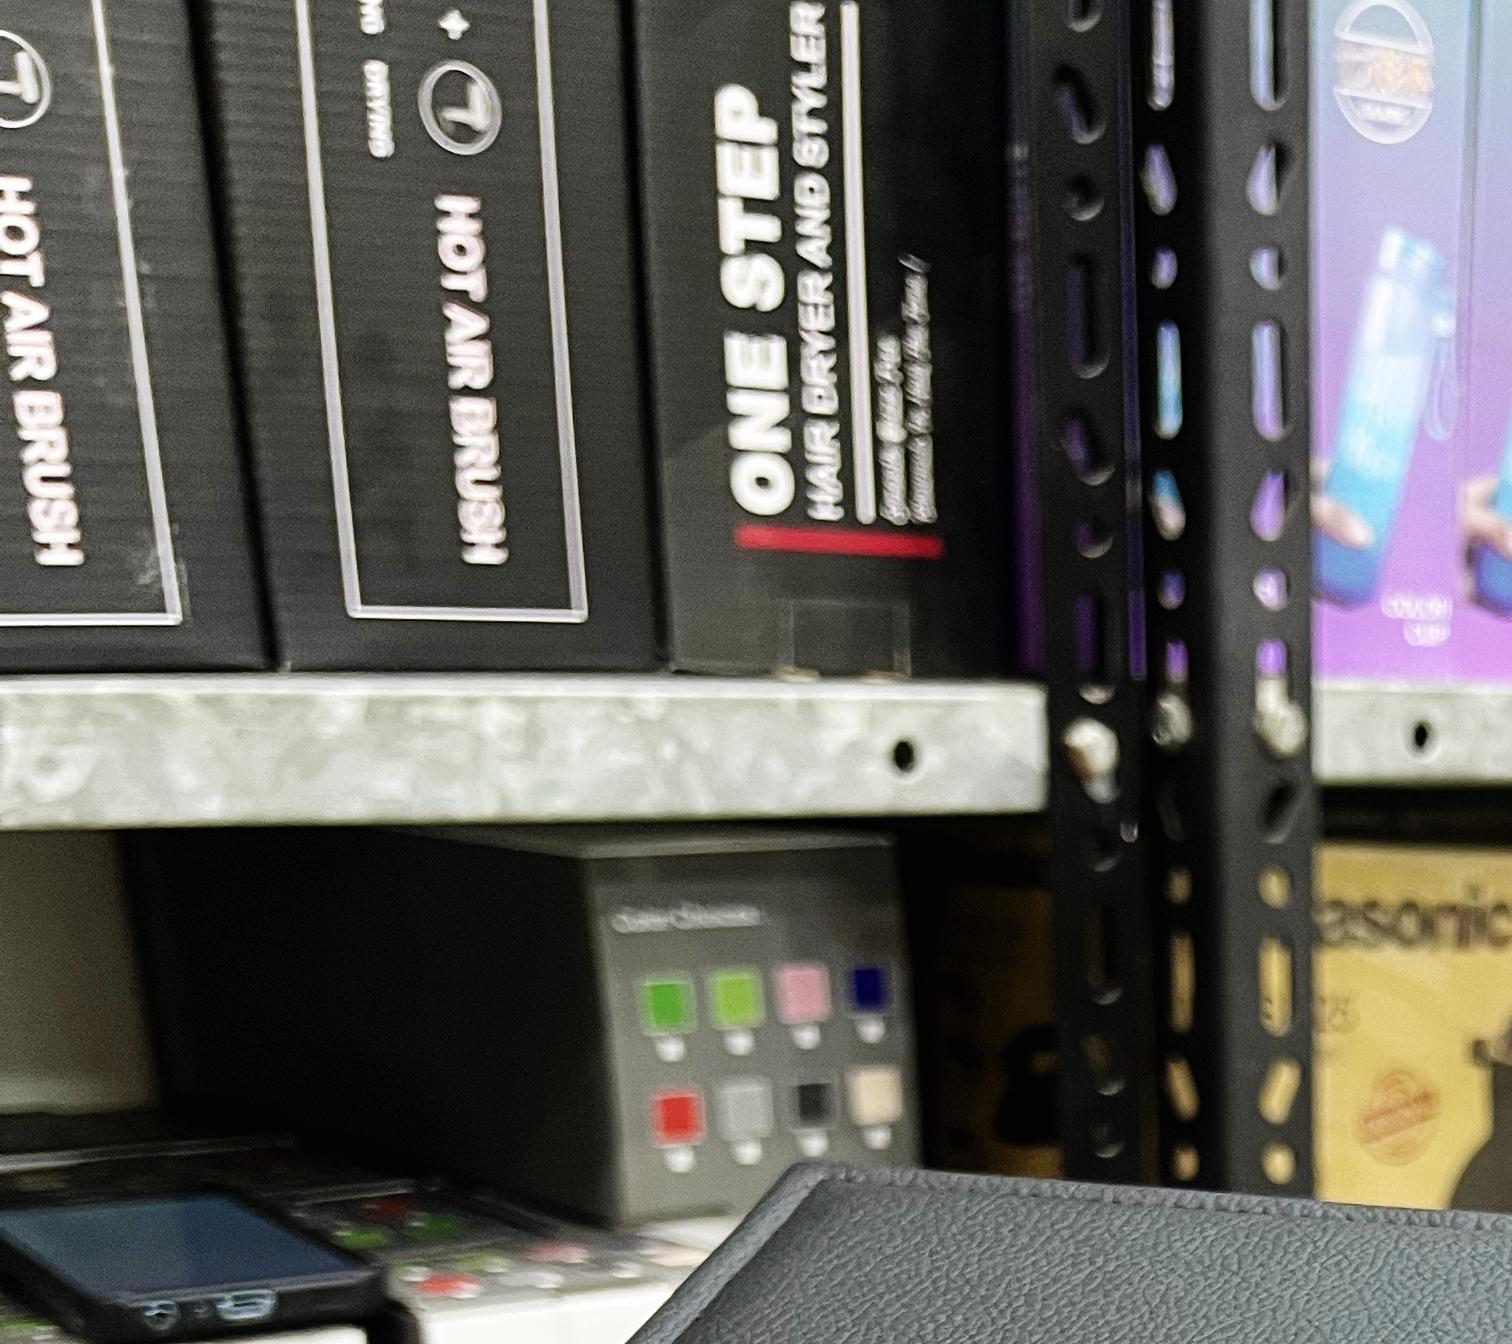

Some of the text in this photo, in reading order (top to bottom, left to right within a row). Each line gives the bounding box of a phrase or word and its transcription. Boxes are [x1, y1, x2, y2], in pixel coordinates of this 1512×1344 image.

[0, 175, 86, 566] HOT AIR BRUSH
[435, 194, 509, 566] HOT AIR BRUSH
[714, 83, 797, 517] ONE STEP
[789, 1, 845, 522] HAIR DRYER AND STYLER
